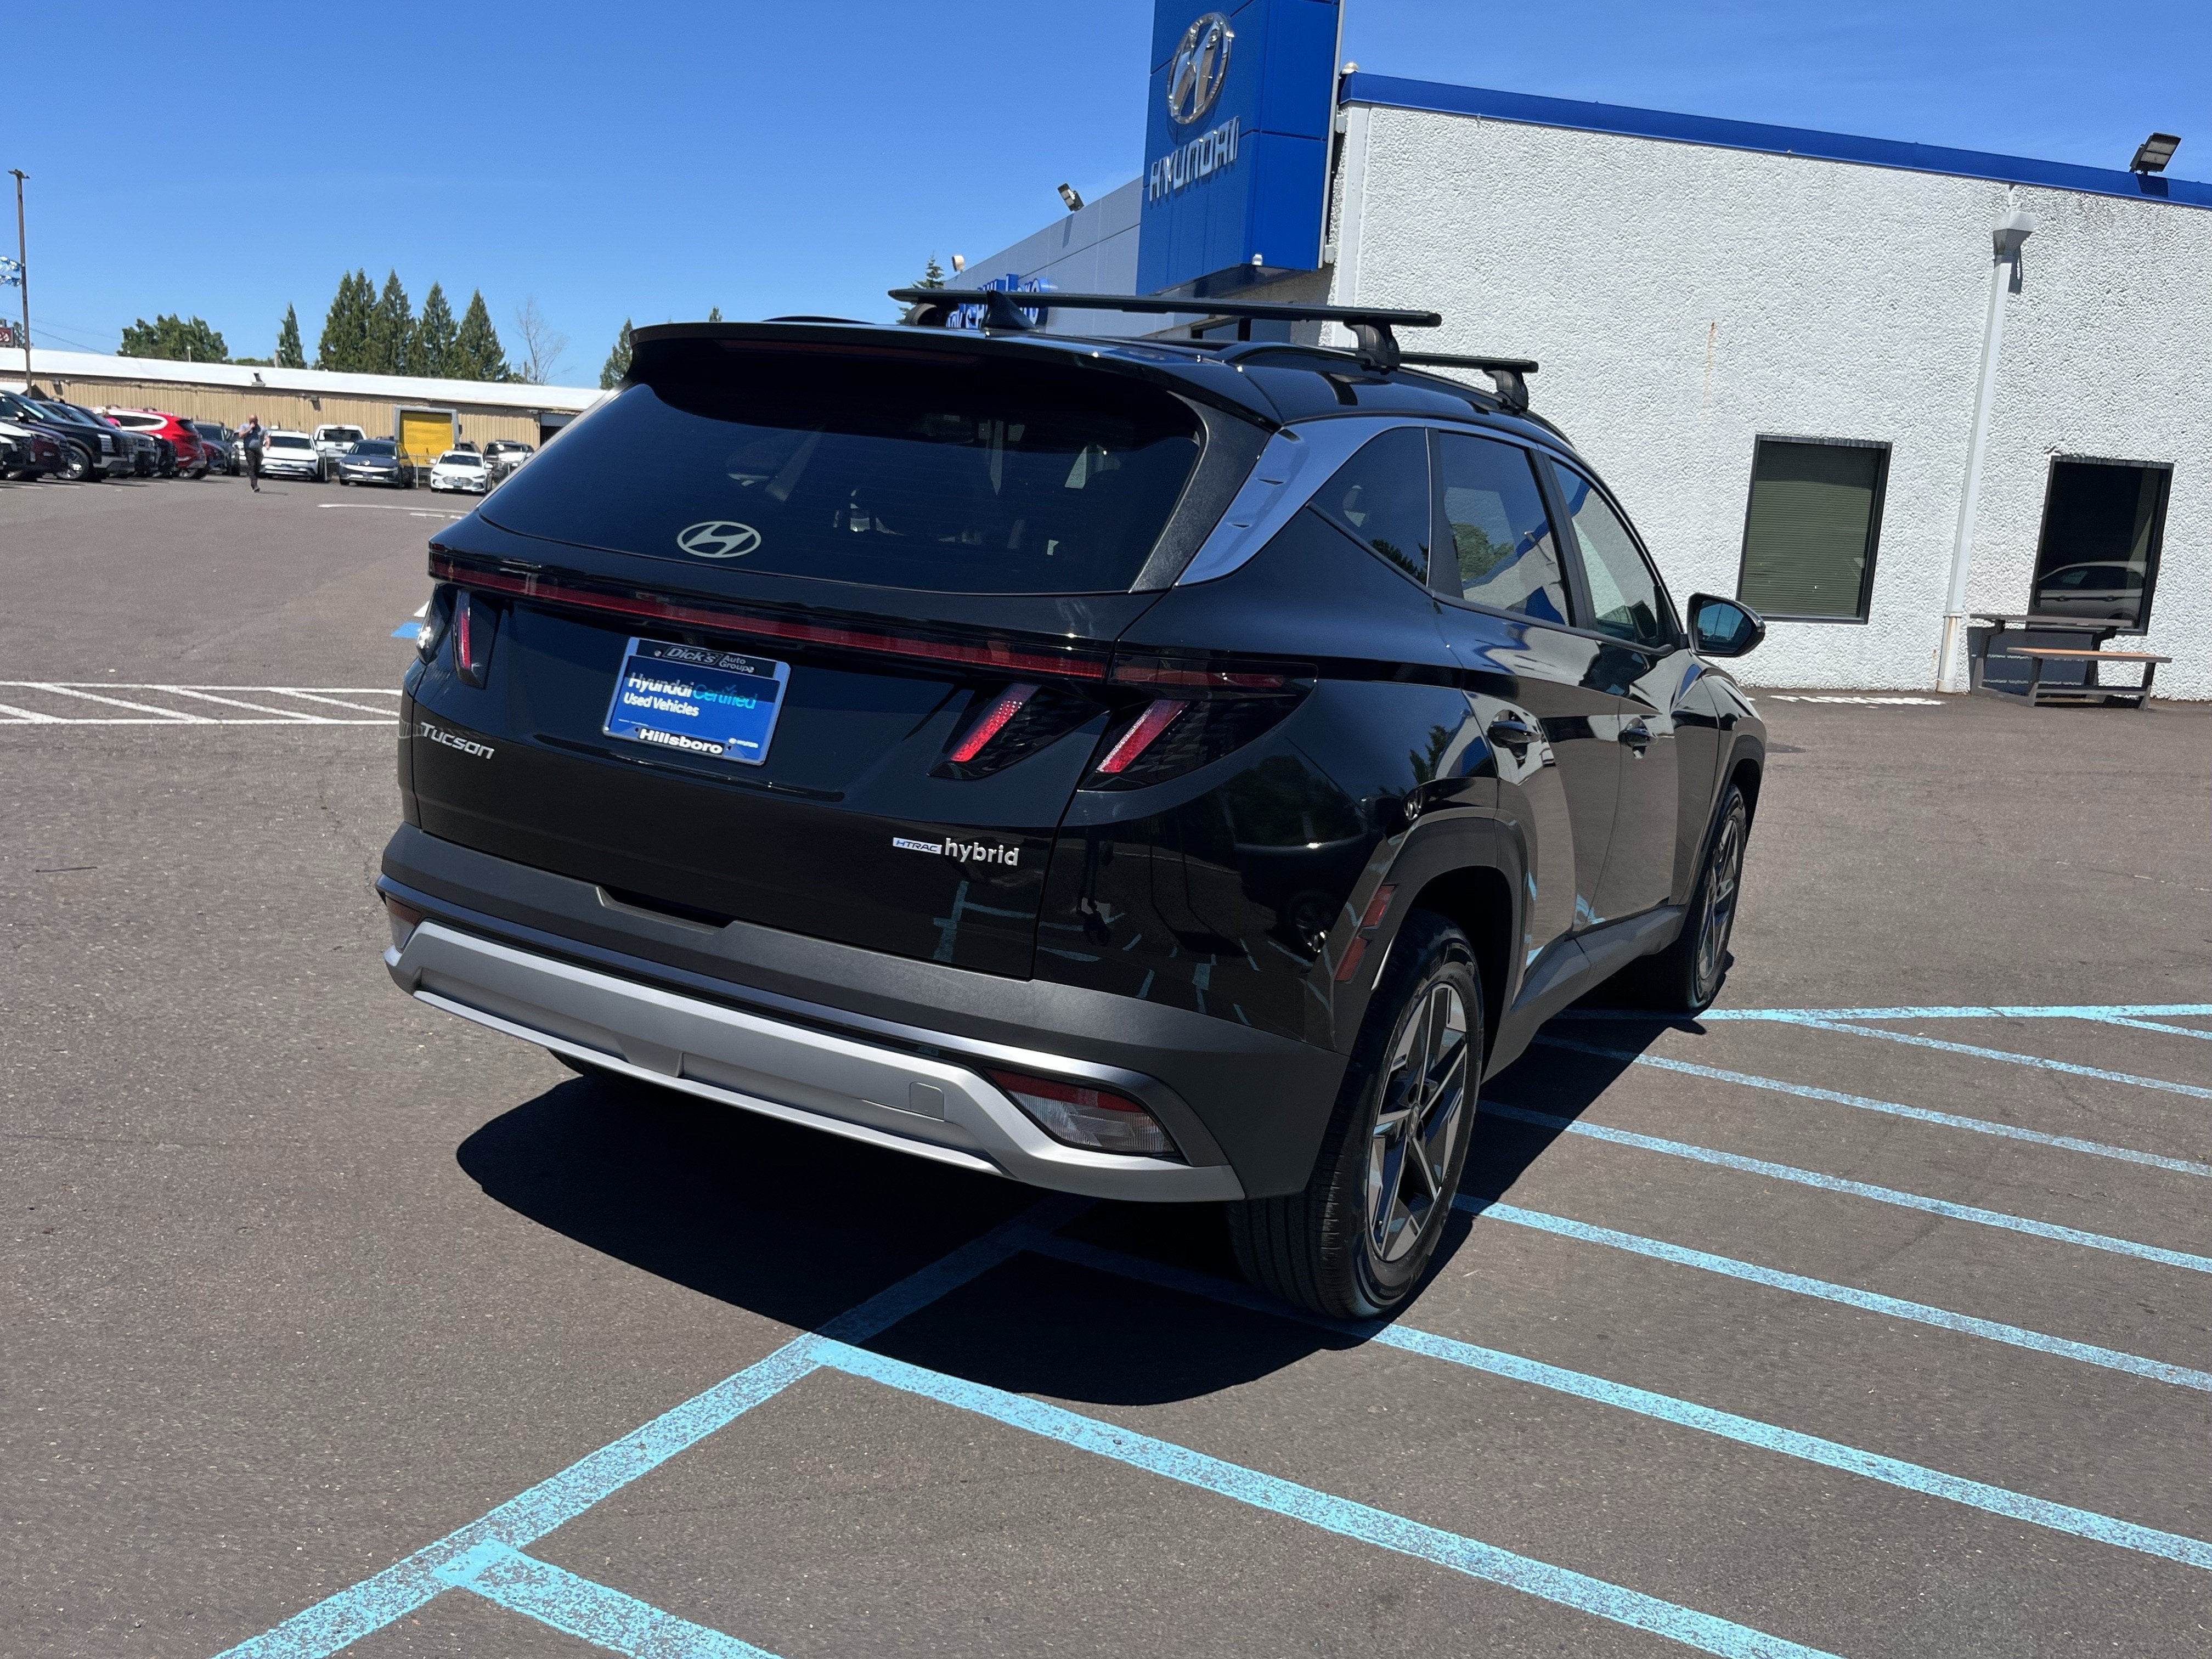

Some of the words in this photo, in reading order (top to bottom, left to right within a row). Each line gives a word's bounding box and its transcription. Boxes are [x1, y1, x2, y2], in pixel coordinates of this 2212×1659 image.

[1149, 115, 1239, 201] HYUNDAI
[667, 648, 716, 664] Dick's
[723, 655, 746, 665] Auto
[628, 672, 695, 697] Hyundai
[693, 684, 758, 709] Certified
[624, 692, 653, 708] Used
[653, 696, 700, 716] Vehicles
[639, 728, 723, 754] Hillsboro
[896, 839, 938, 852] HTRAC
[945, 837, 1019, 866] hybrid
